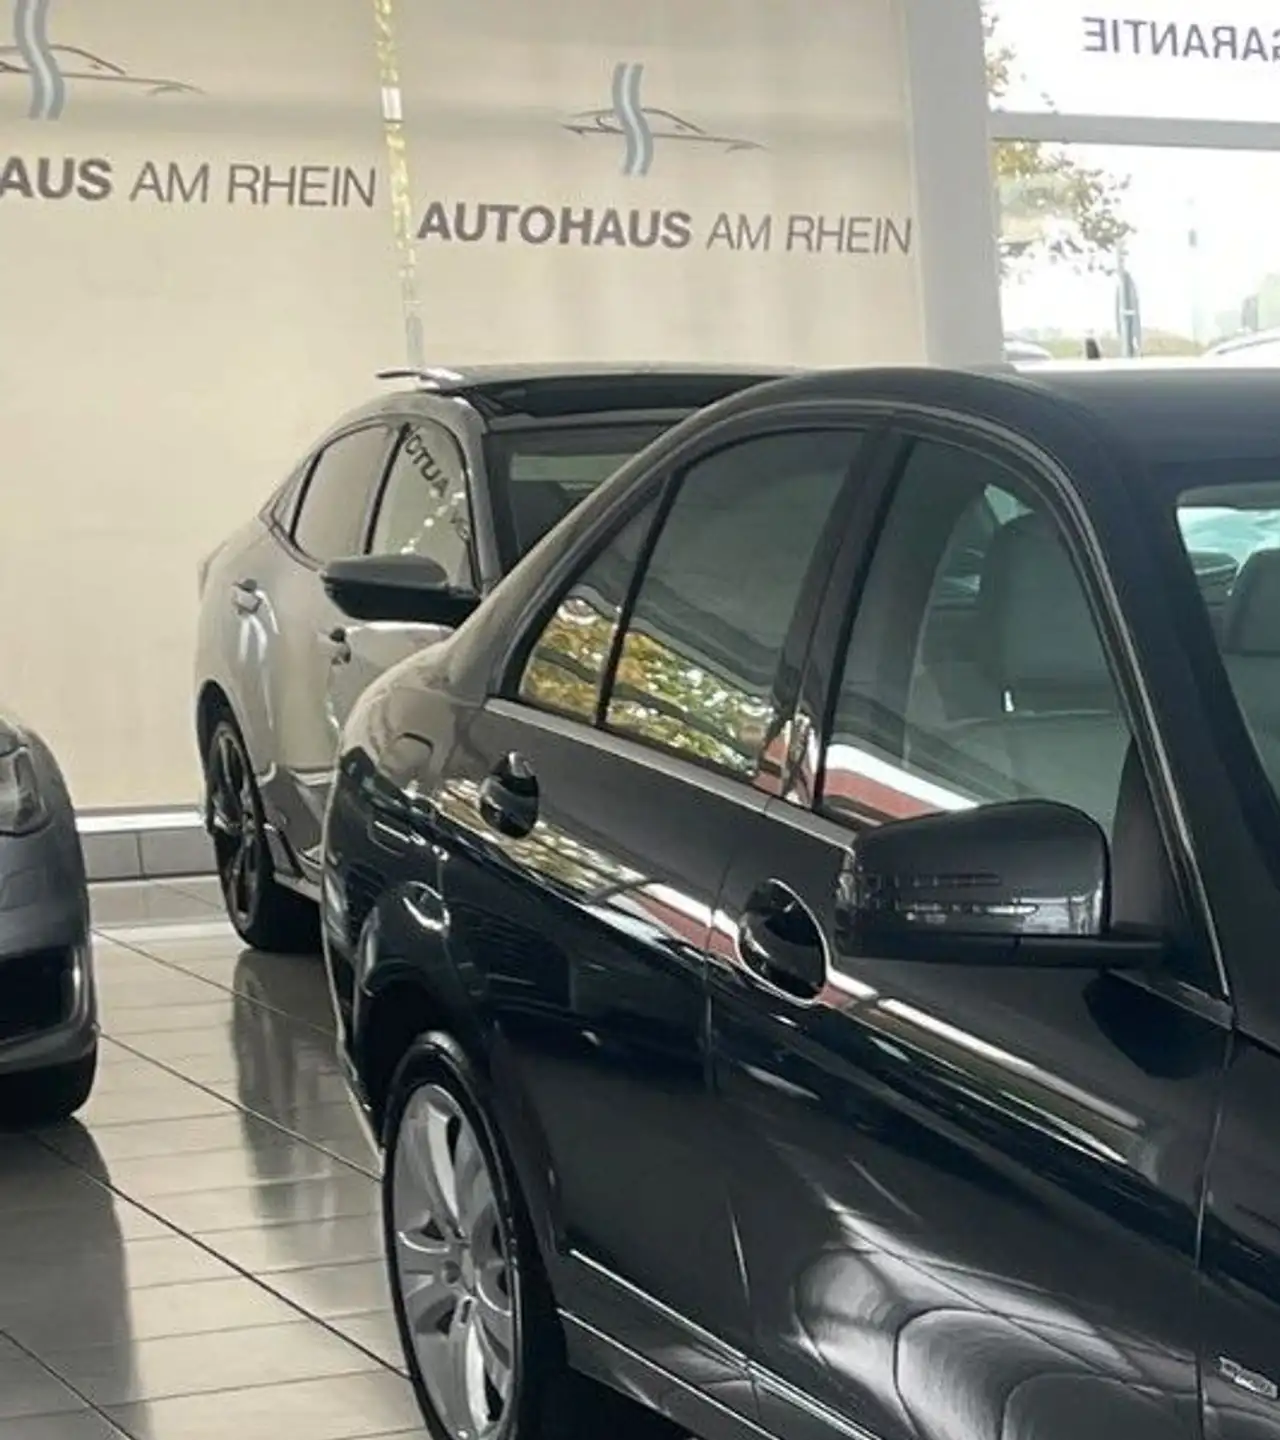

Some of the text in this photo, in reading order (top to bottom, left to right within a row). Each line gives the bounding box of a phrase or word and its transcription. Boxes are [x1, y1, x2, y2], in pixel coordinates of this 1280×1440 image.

[129, 160, 210, 204] AM
[227, 163, 376, 208] RHEIN
[416, 201, 913, 256] AUTOHAUS AM RHEIN
